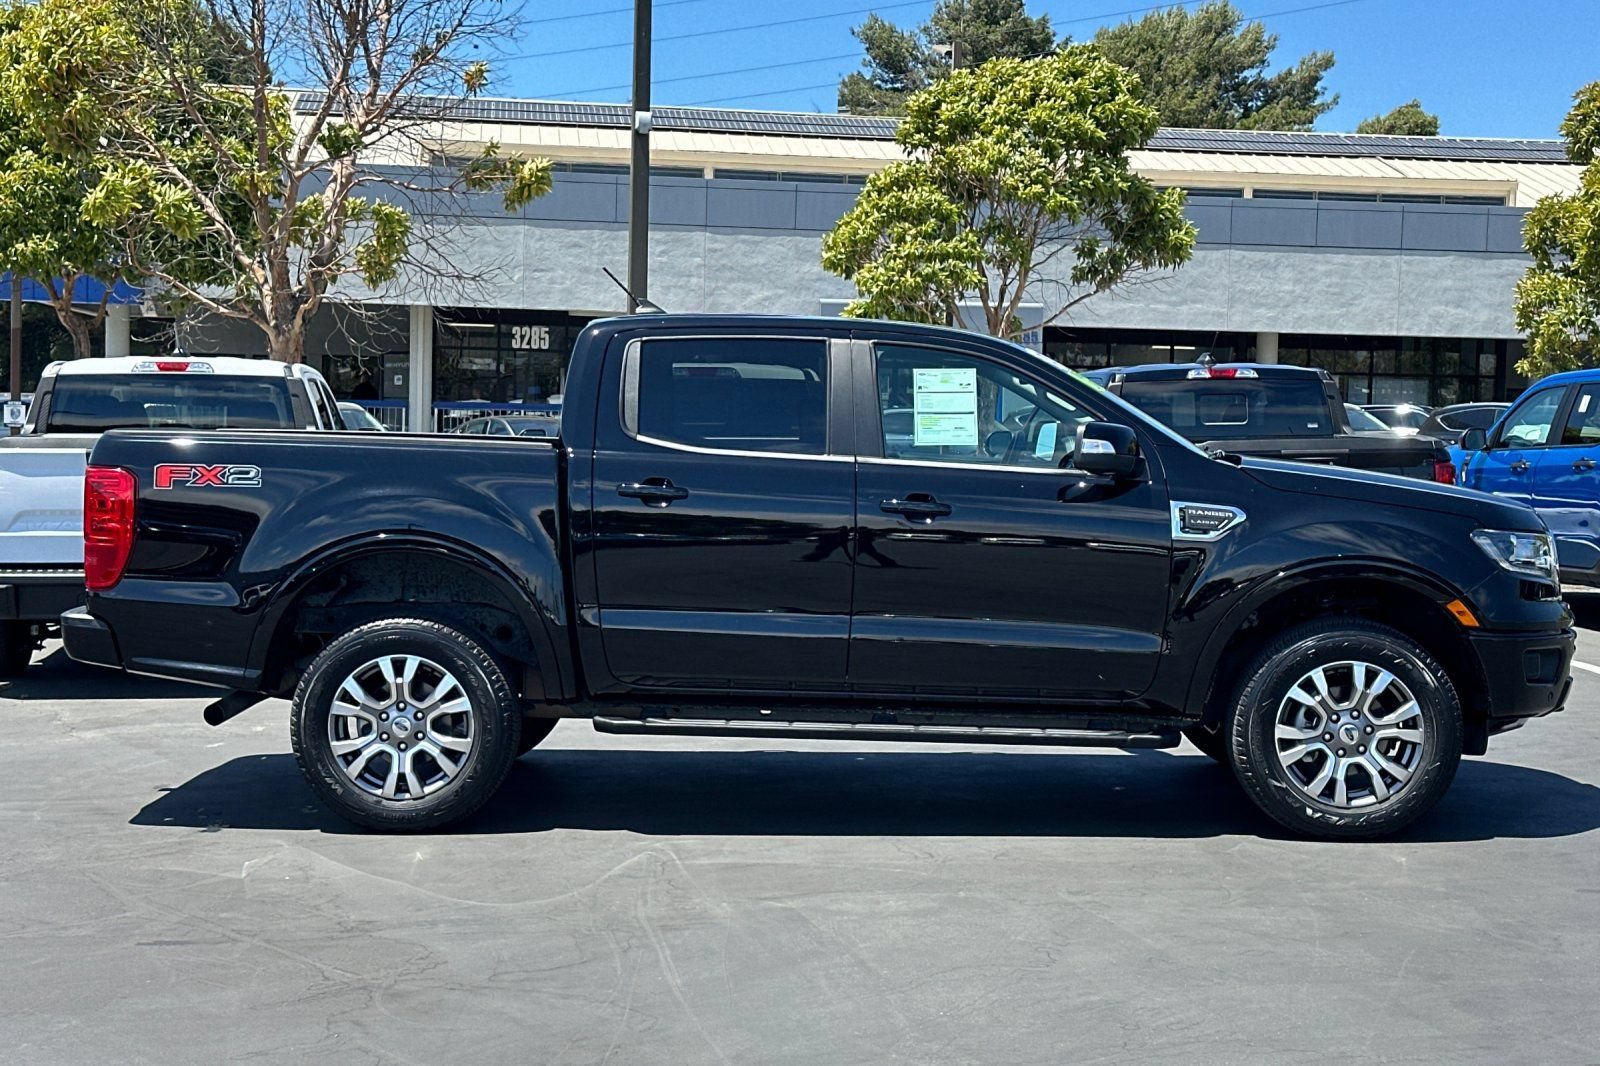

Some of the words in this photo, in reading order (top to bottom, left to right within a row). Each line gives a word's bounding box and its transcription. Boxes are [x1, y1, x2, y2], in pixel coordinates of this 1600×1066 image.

[511, 326, 550, 350] 3285
[153, 463, 262, 490] FX2
[1188, 508, 1233, 518] RANGER
